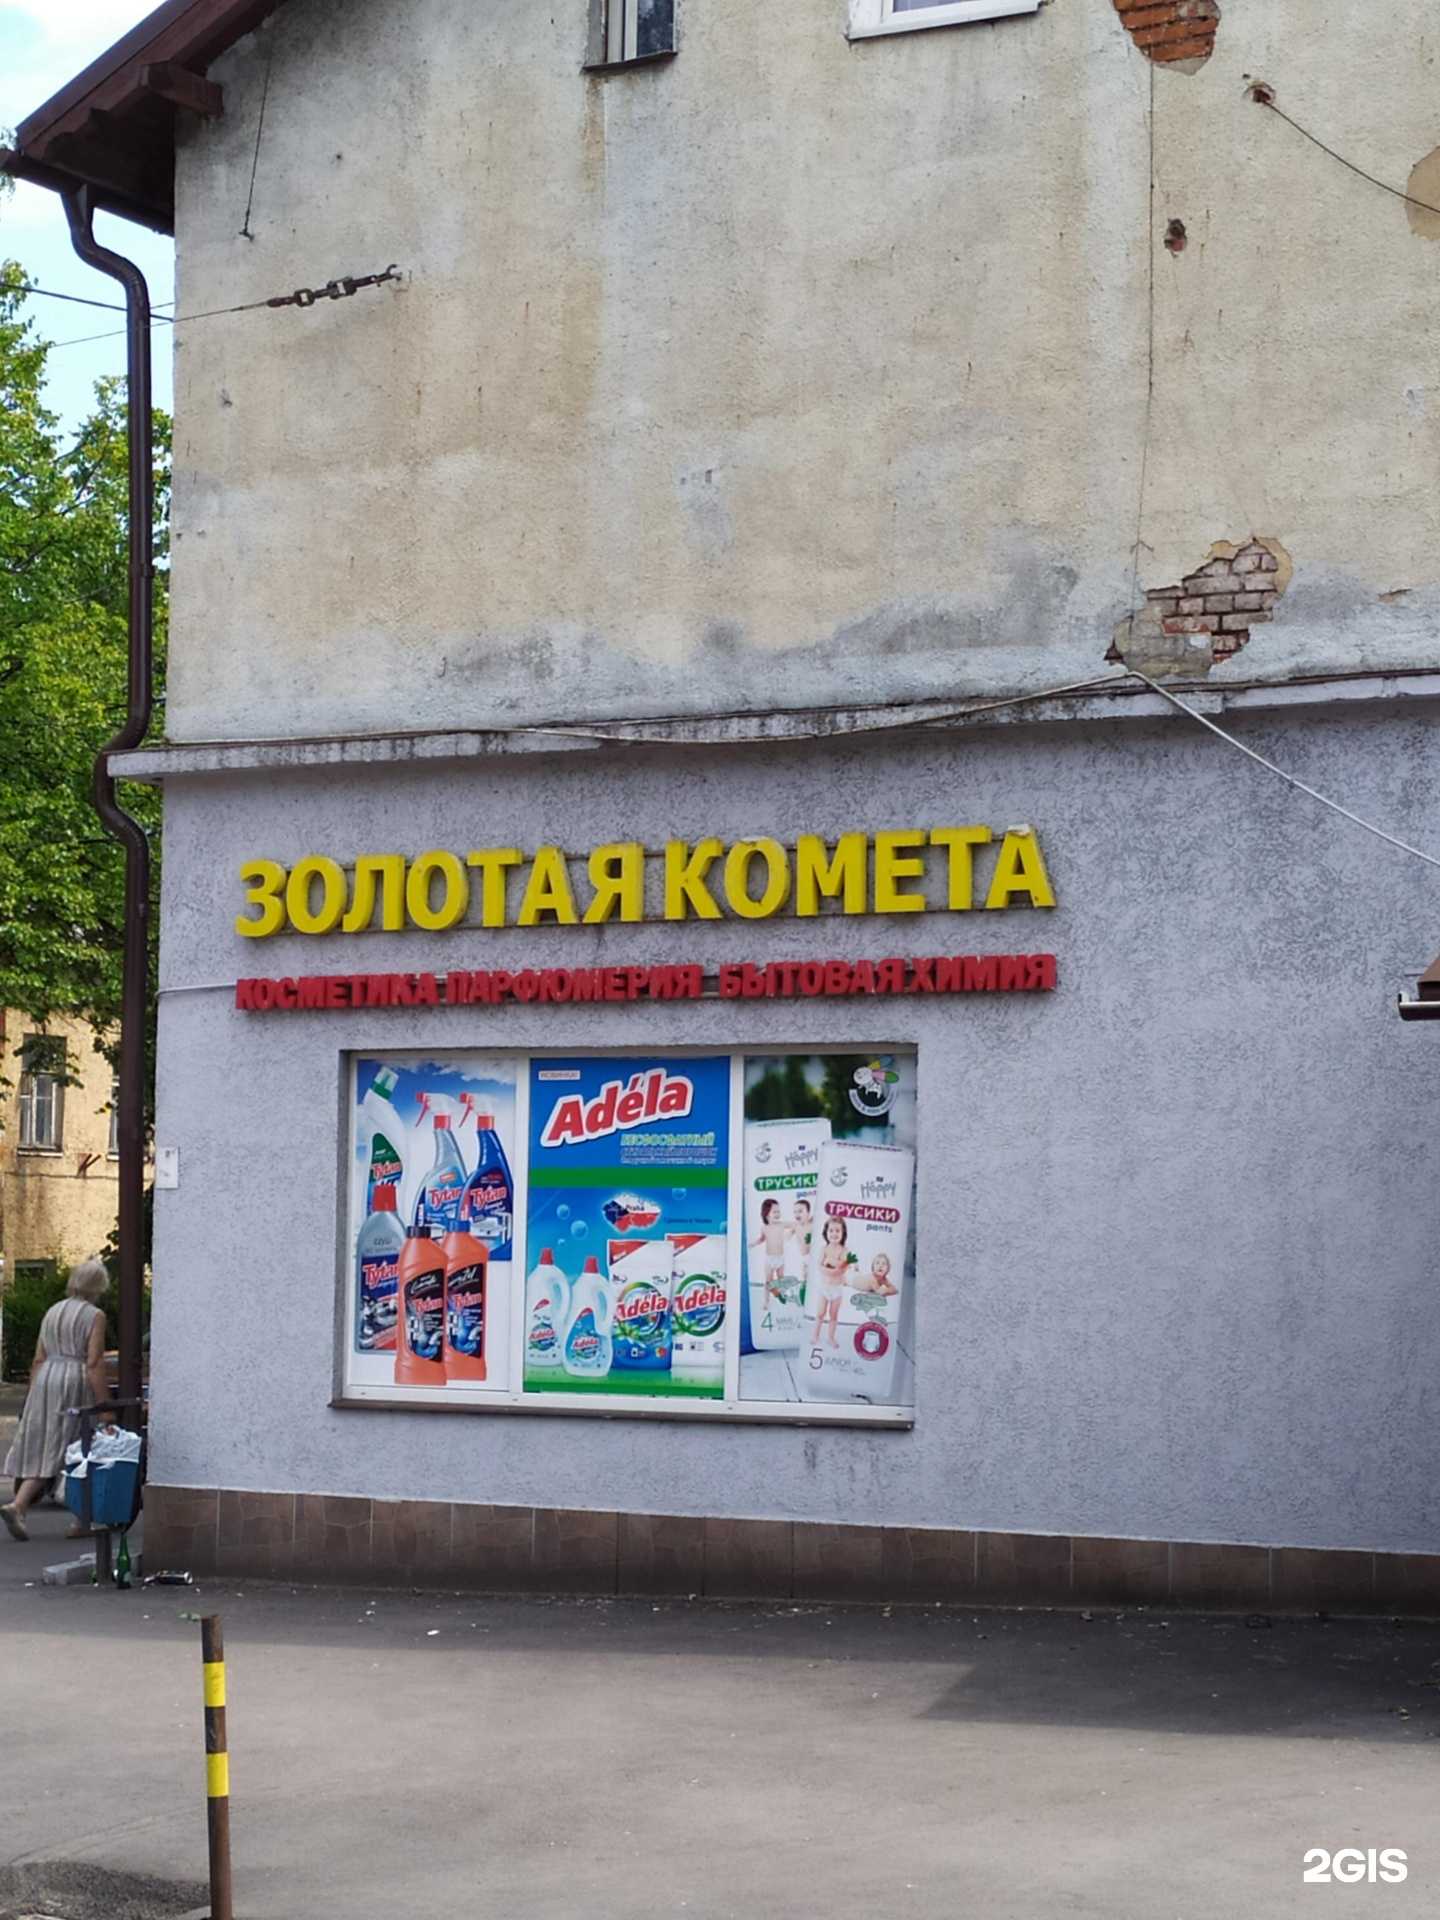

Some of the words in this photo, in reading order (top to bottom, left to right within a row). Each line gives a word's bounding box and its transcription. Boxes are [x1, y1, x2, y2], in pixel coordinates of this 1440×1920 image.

[235, 841, 646, 938] ЗОЛОТАЯ
[664, 823, 1057, 920] КОМЕТА
[236, 972, 439, 1010] КОСМЕТИКА
[447, 963, 704, 1006] ПАРФЮМЕРИЯ
[719, 957, 905, 998] БЫТОВАЯ
[910, 954, 1057, 992] ХИМИЯ
[543, 1070, 691, 1145] Adéla
[796, 1189, 817, 1200] pant
[828, 1203, 897, 1222] ТРУСИКИ
[809, 1348, 823, 1370] 5
